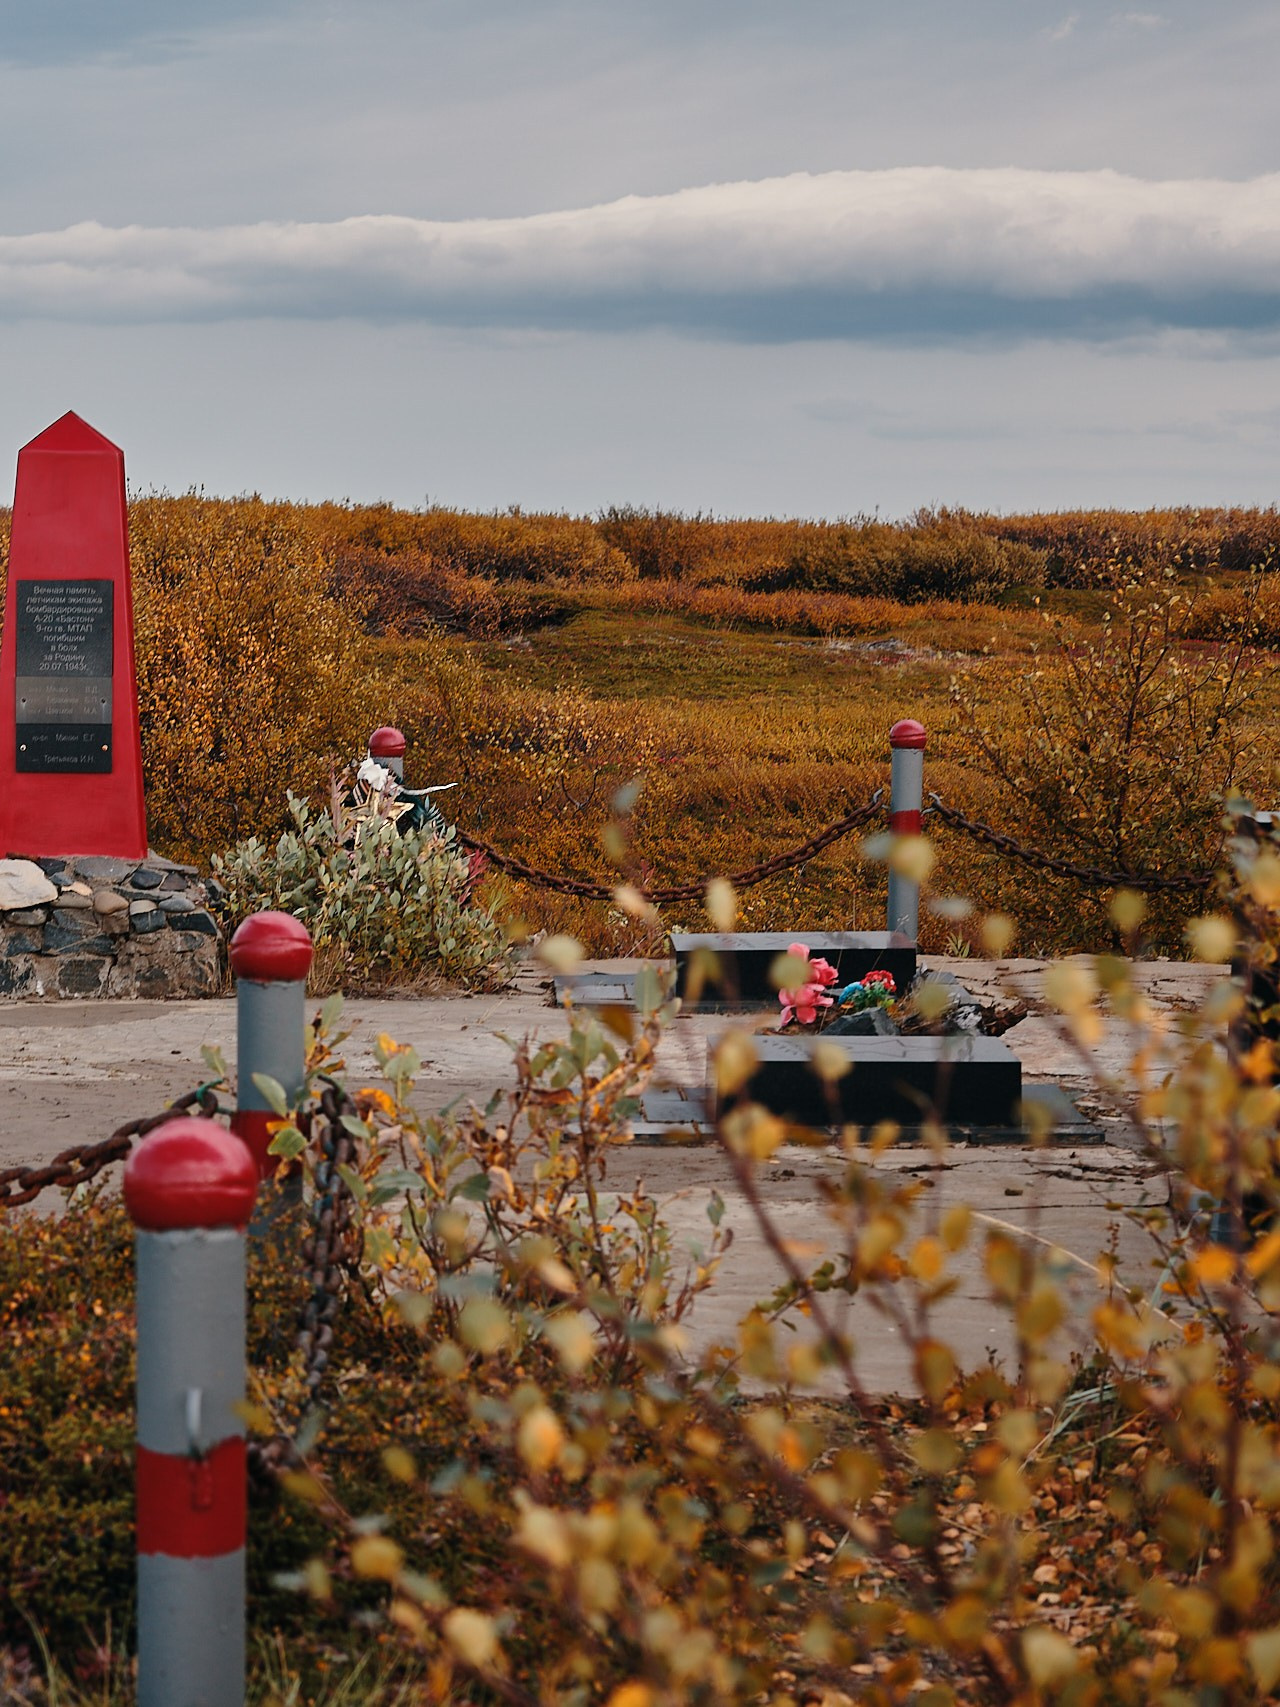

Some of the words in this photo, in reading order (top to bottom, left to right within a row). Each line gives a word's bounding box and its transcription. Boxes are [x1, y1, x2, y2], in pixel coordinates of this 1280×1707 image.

[33, 585, 64, 595] Вечная
[65, 587, 96, 595] память
[67, 597, 102, 605] экипажа
[25, 605, 103, 615] бомбардировщика
[67, 624, 93, 633] МТАП
[43, 634, 86, 643] погибшим
[57, 643, 78, 652] боях
[54, 653, 86, 664] Родину
